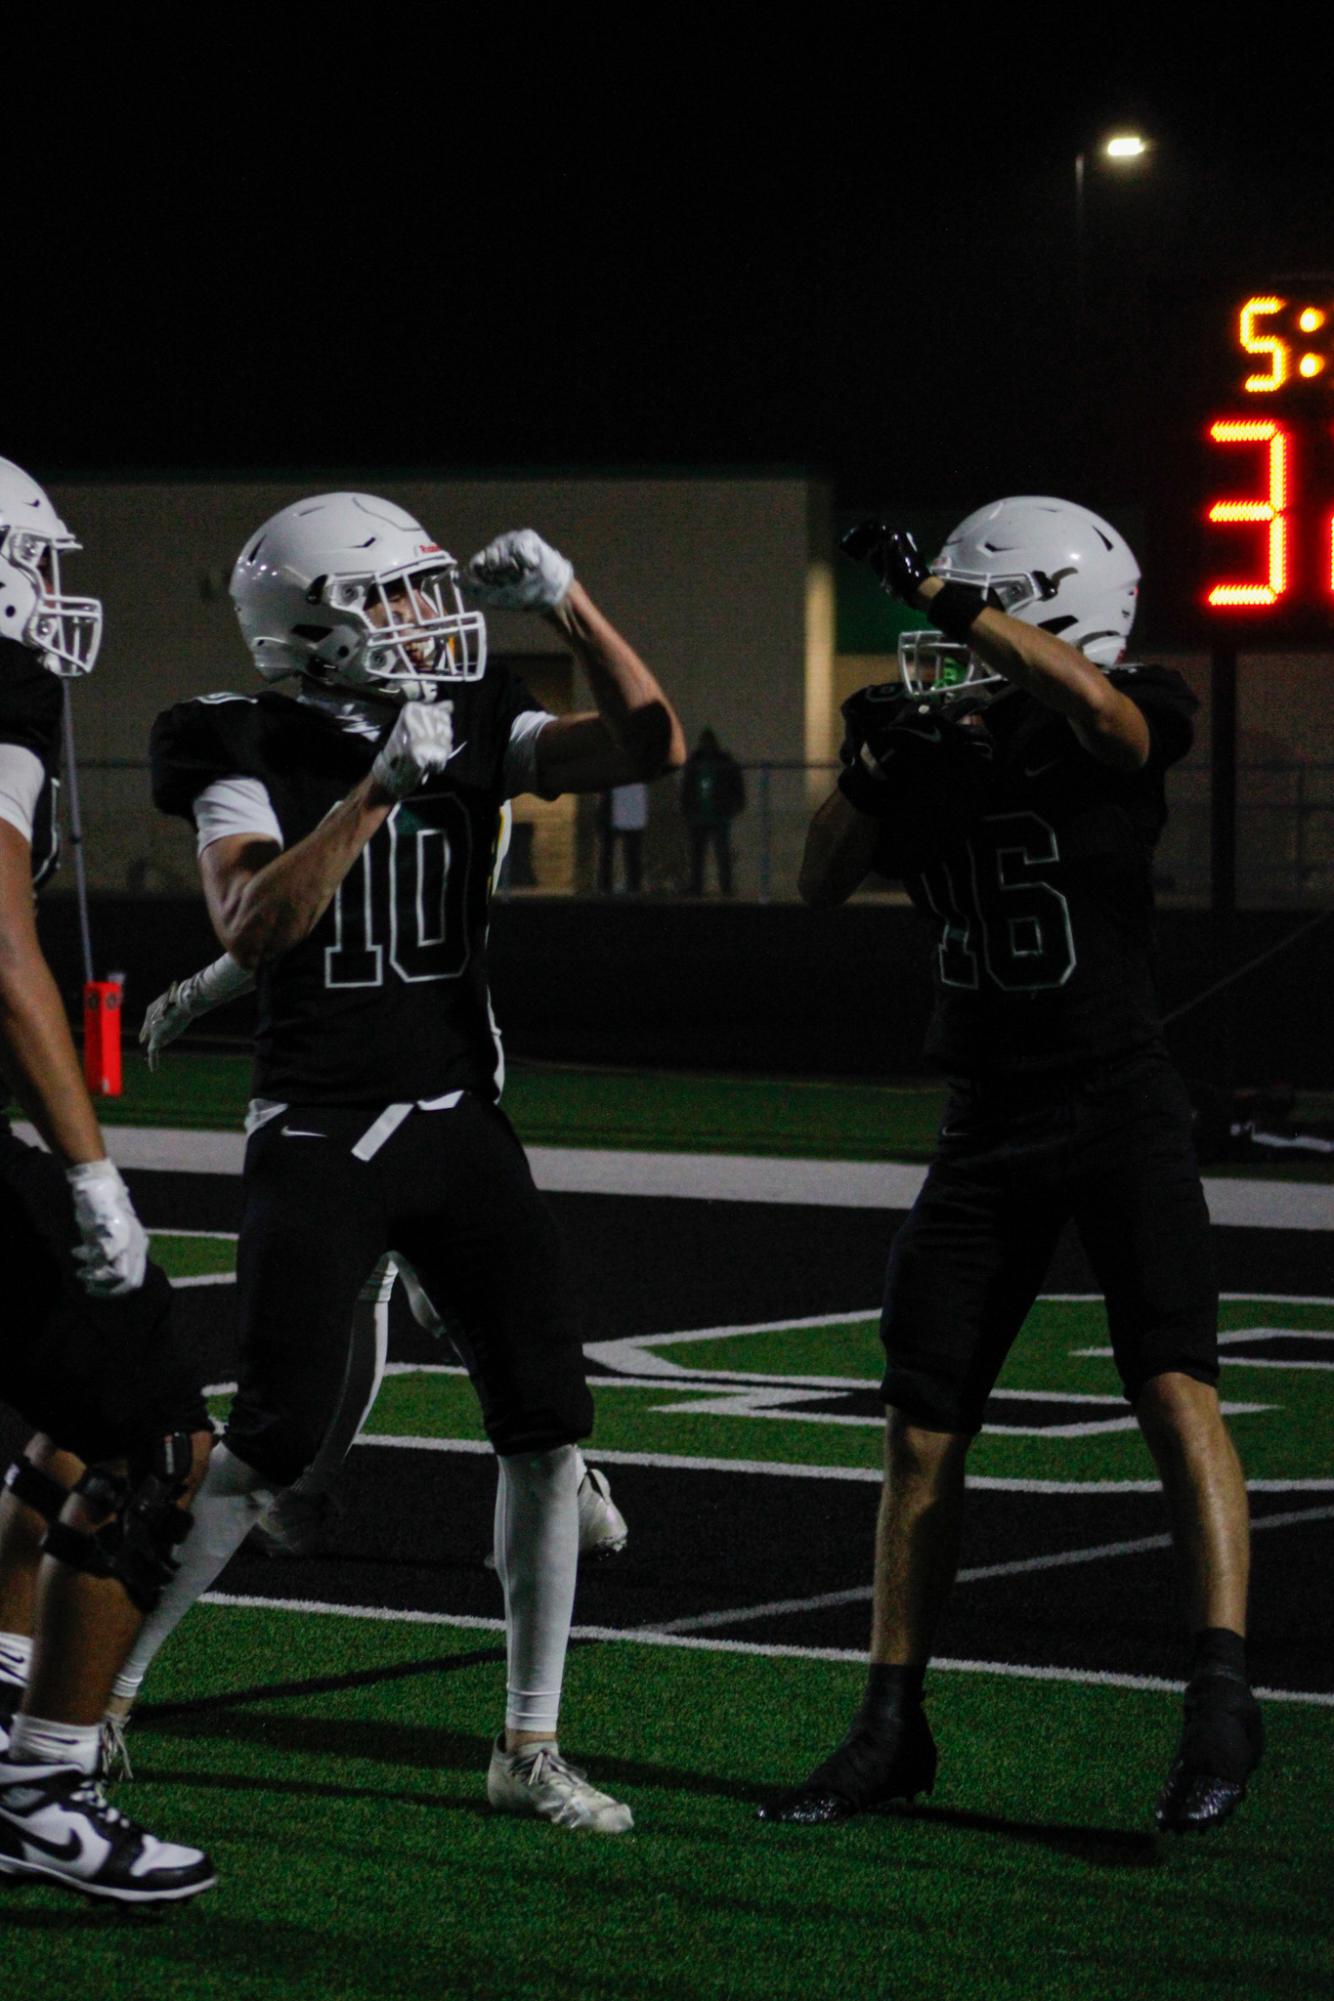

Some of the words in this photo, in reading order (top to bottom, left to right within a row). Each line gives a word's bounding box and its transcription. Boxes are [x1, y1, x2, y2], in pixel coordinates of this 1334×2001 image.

[1207, 417, 1334, 607] 3
[322, 791, 474, 990] 10
[919, 809, 1077, 993] 16
